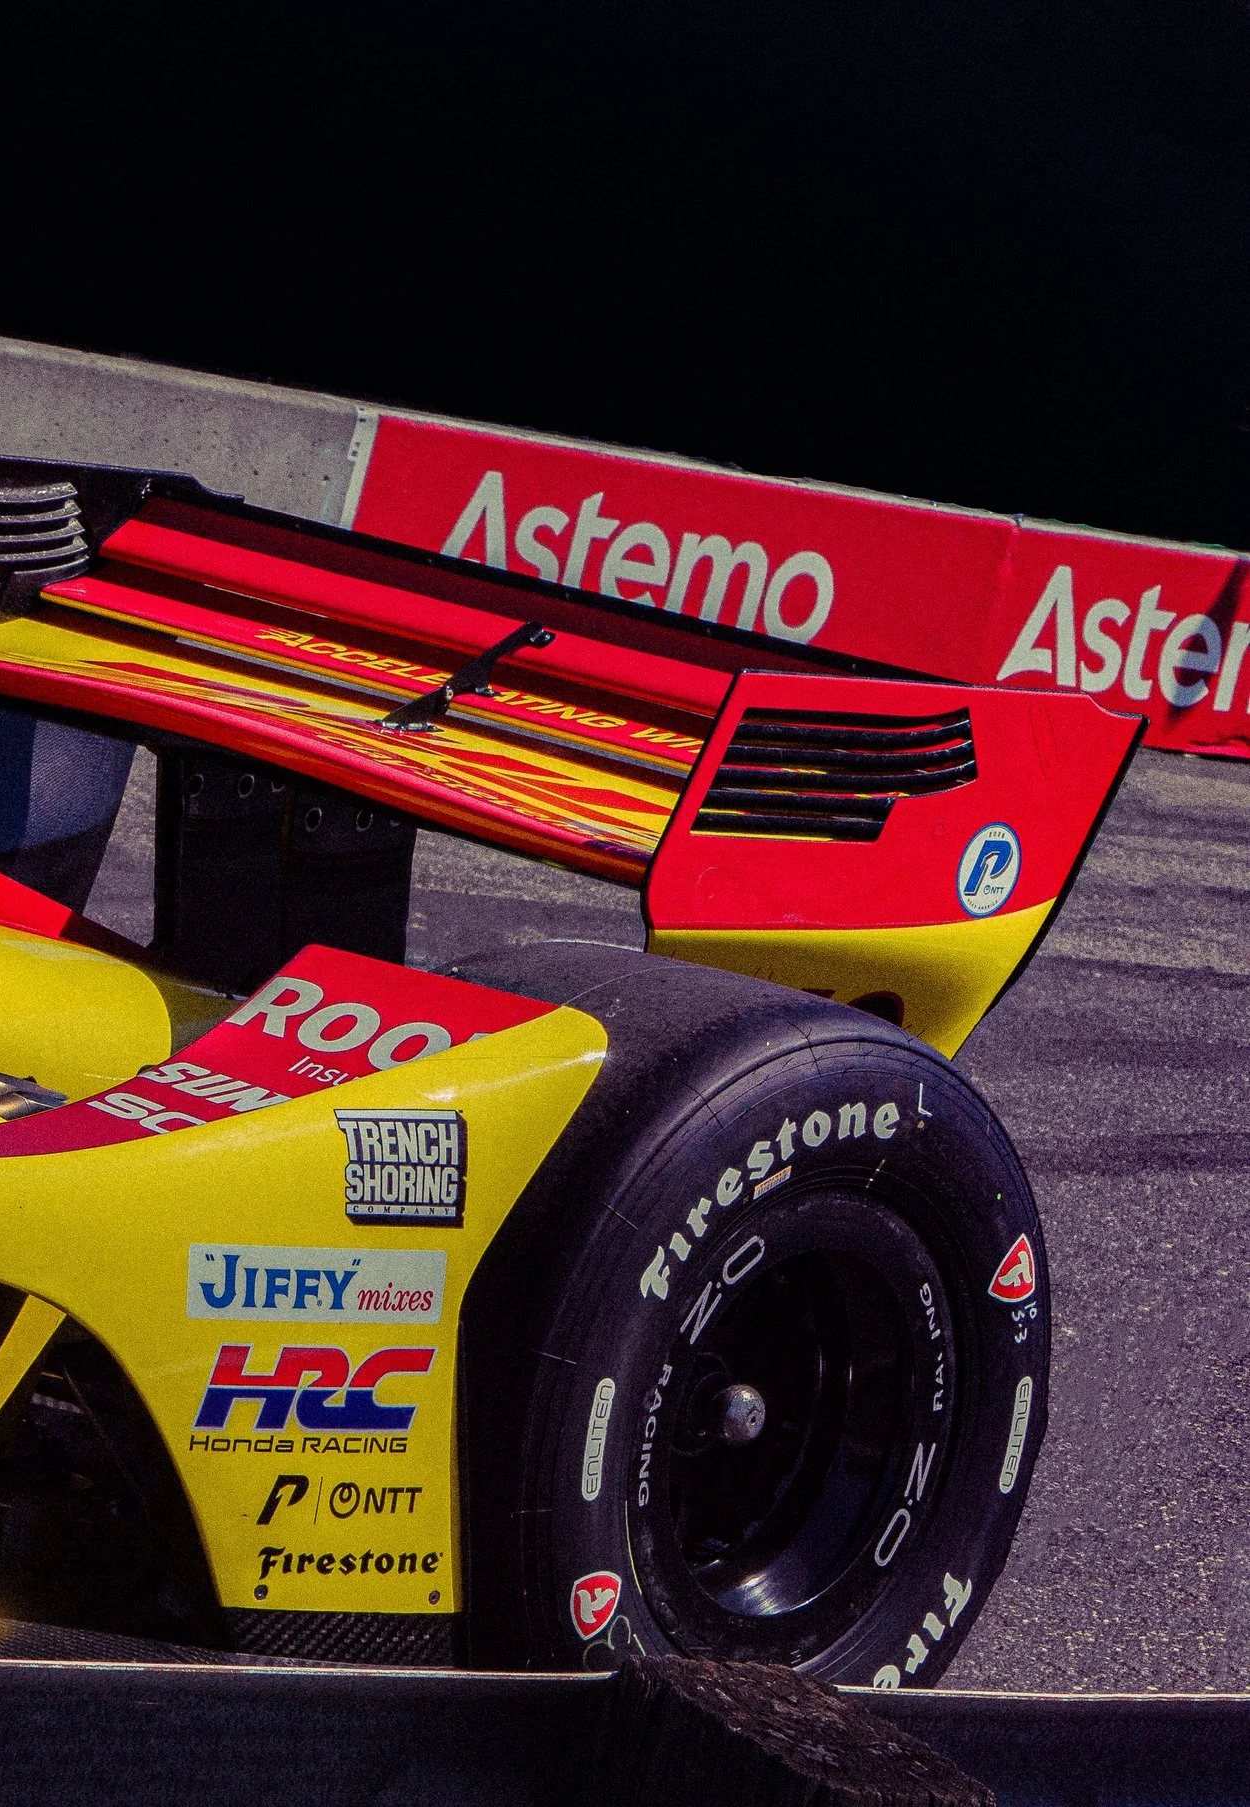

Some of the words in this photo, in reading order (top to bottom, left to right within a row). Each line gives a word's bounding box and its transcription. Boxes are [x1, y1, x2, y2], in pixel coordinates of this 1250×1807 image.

[439, 470, 834, 645] Astemo
[254, 628, 627, 729] ACCELEATING
[629, 727, 705, 754] WI
[225, 976, 493, 1070] ROO
[288, 1056, 358, 1086] Insu
[338, 1121, 459, 1165] TRENCH
[346, 1163, 458, 1204] SHORING
[353, 1205, 450, 1215] COMPANY
[640, 1101, 899, 1301] Firestone
[357, 1282, 434, 1312] mixes
[192, 1343, 438, 1432] HRC
[189, 1435, 295, 1453] Honda
[301, 1436, 409, 1454] RACING
[583, 1381, 614, 1498] ENLITEN
[636, 1363, 673, 1508] RACING
[1001, 1379, 1031, 1490] ENLITEN
[363, 1486, 423, 1515] NTT
[257, 1545, 441, 1580] Firestone
